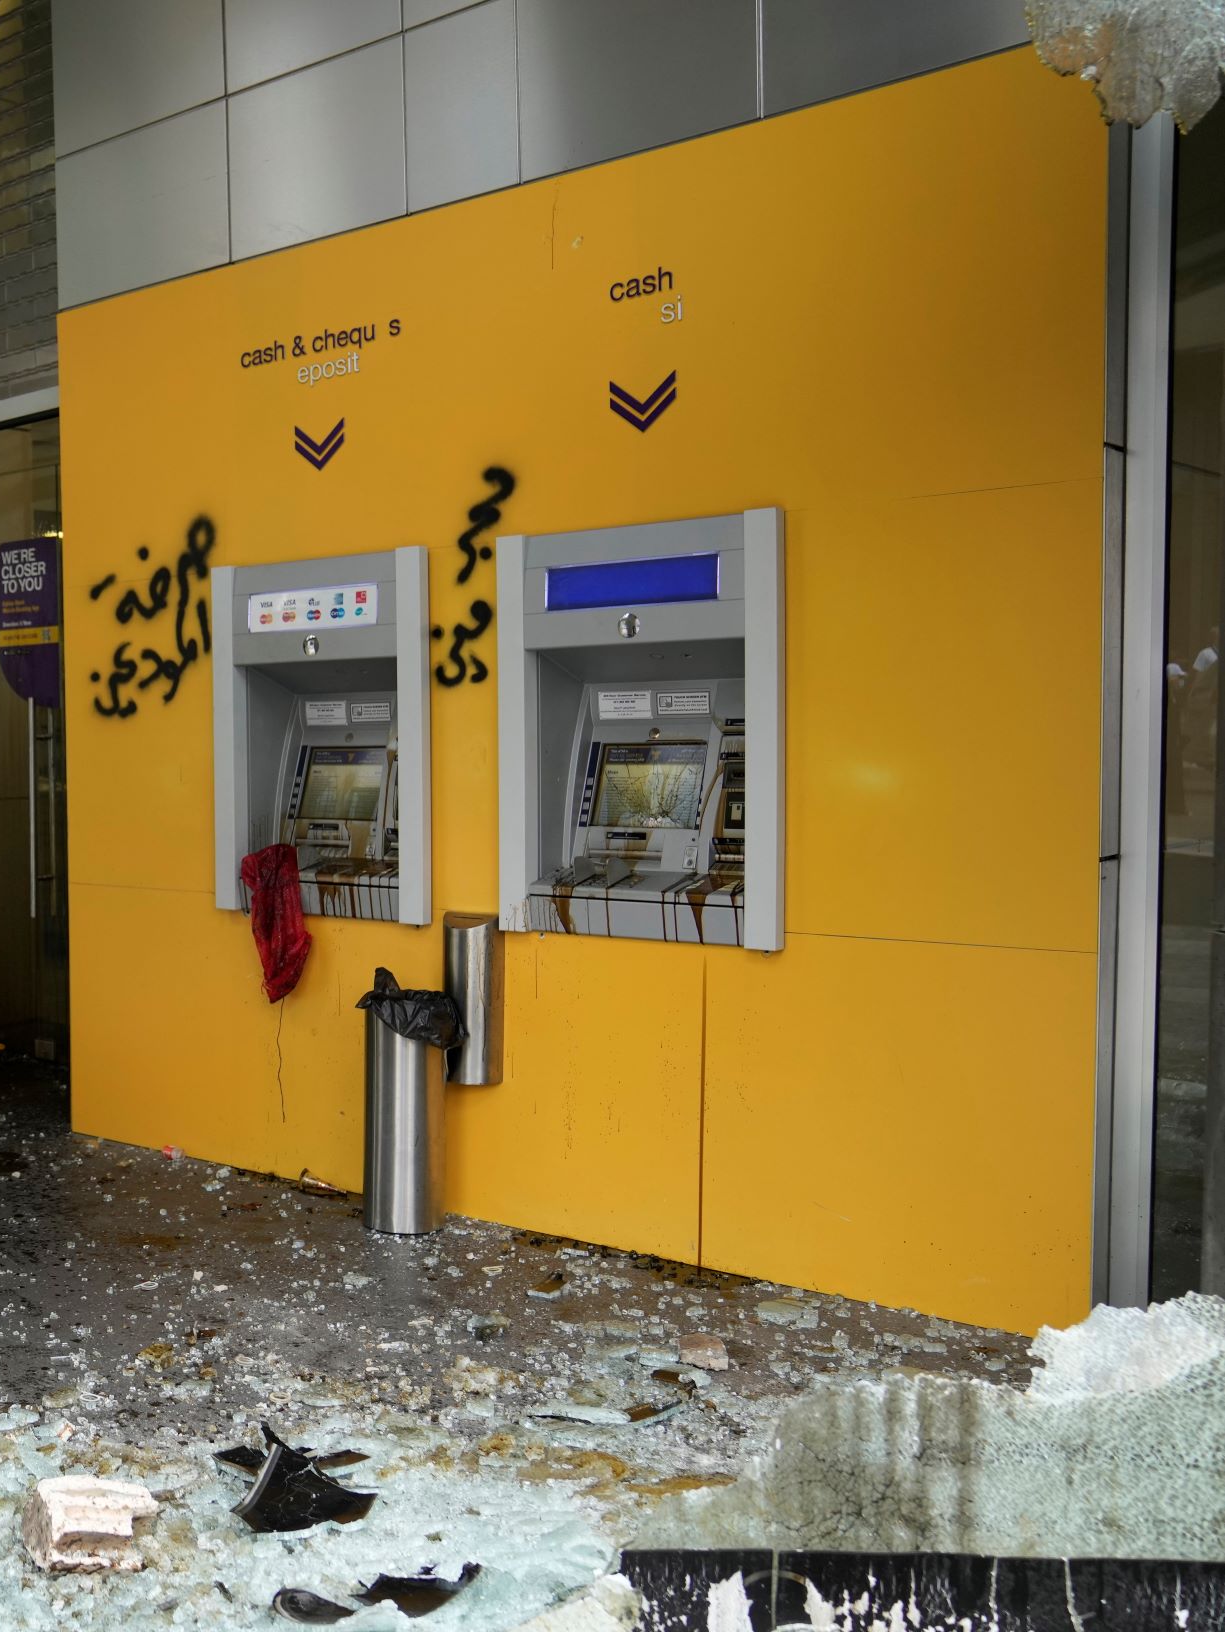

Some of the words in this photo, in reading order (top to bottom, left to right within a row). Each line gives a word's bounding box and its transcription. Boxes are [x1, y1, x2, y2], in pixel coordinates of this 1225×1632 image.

[609, 266, 673, 302] cash
[661, 294, 683, 323] si
[240, 340, 286, 368] cash
[291, 335, 307, 357] &
[297, 351, 360, 386] eposit
[1, 547, 36, 565] WE'RE
[1, 561, 47, 580] CLOSER
[2, 580, 17, 594] TO
[18, 576, 43, 592] YOU
